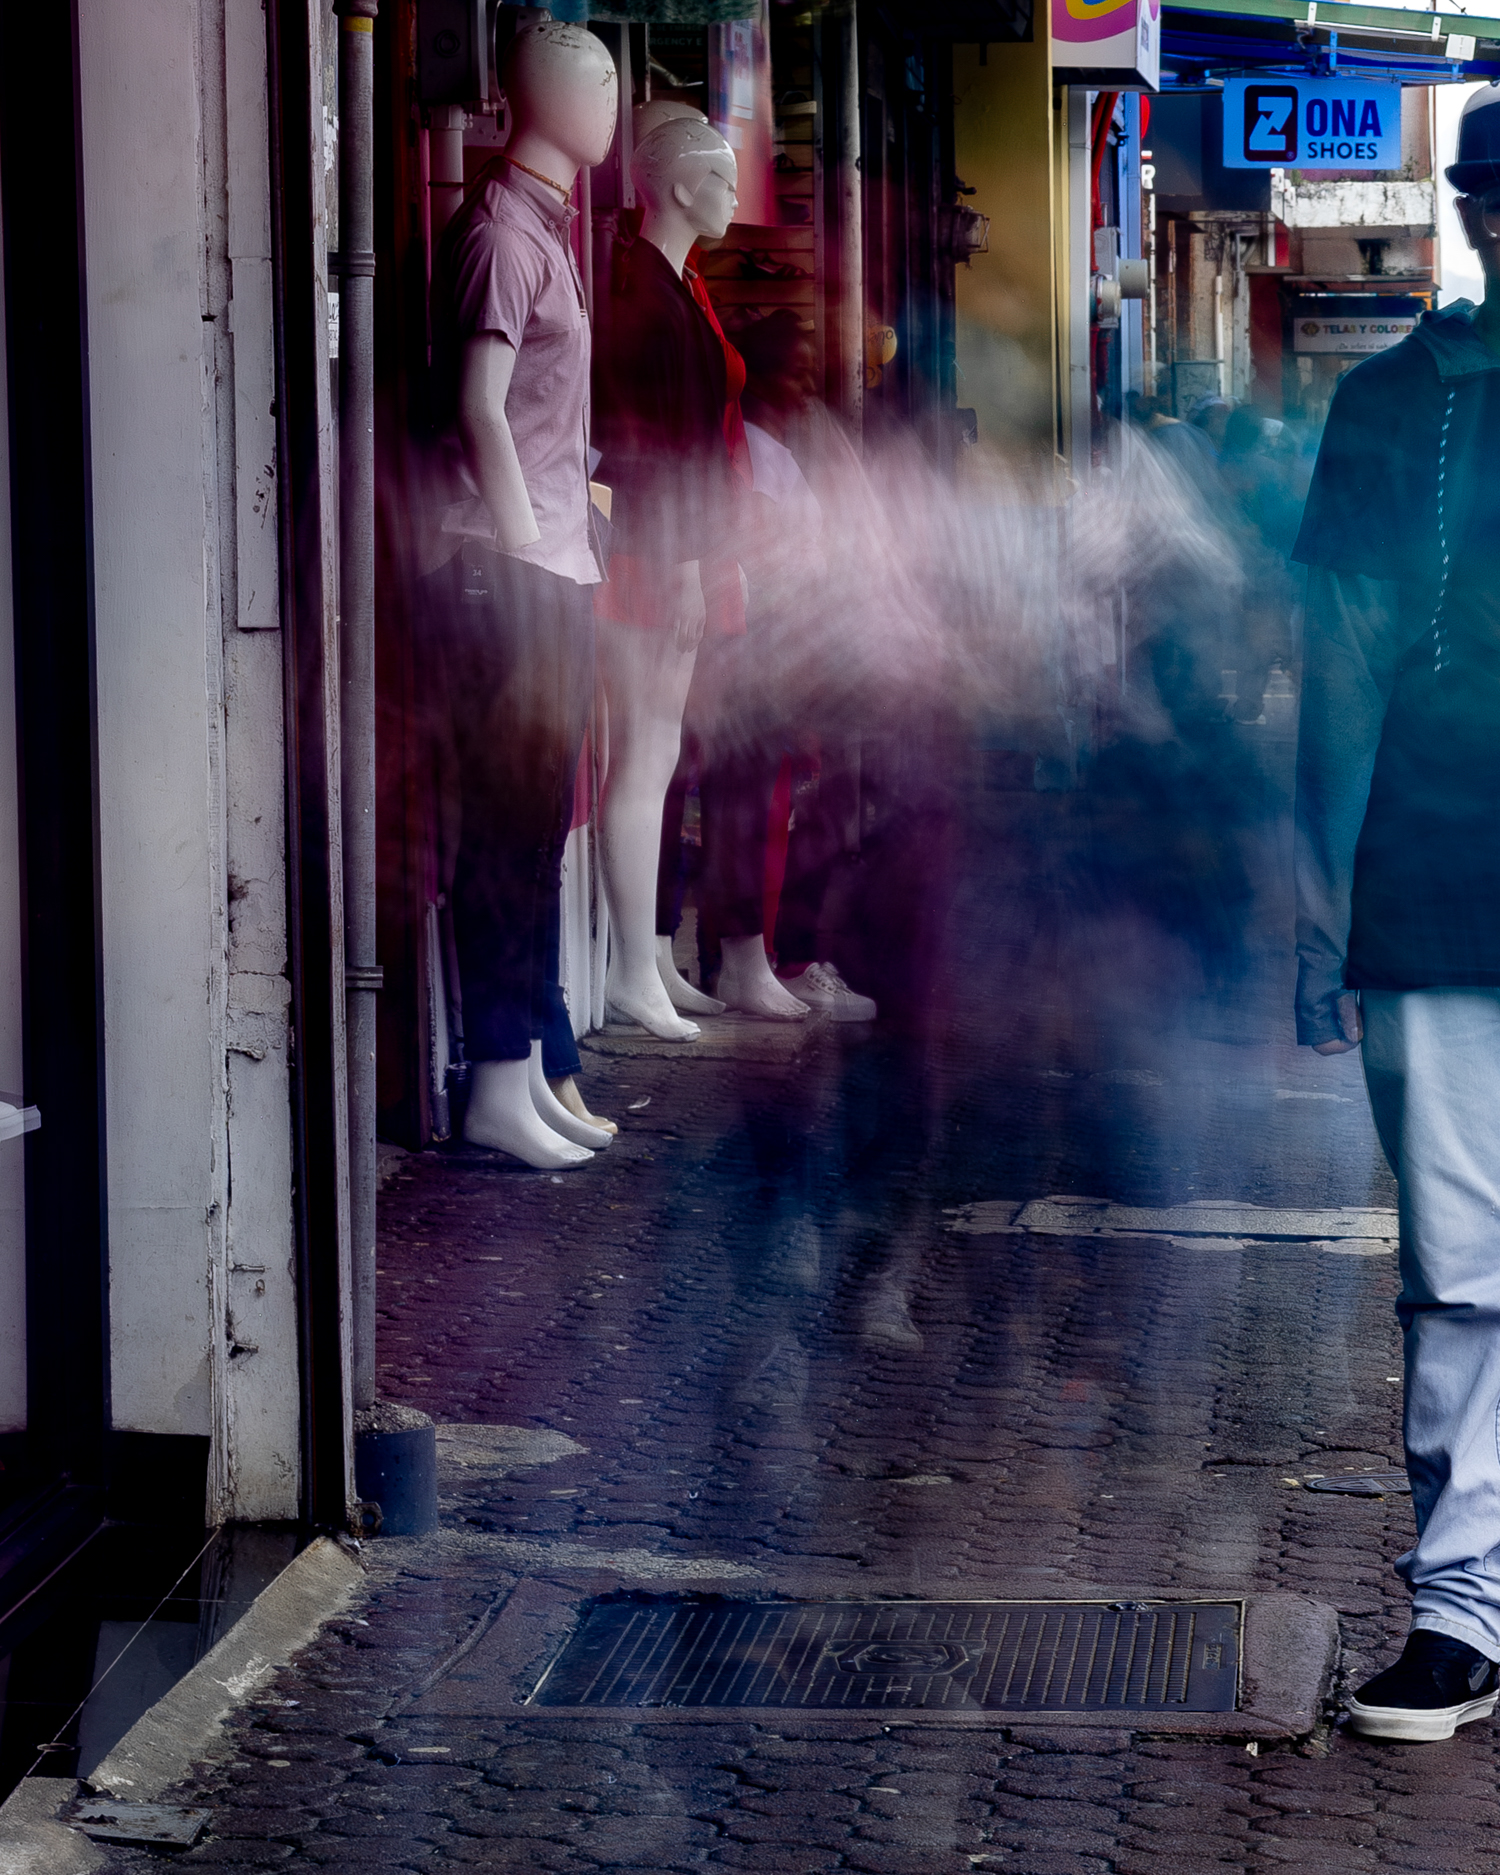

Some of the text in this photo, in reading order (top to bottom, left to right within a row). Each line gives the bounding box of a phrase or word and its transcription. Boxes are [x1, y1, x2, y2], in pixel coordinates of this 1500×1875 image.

[1308, 142, 1378, 159] SHOES
[1323, 324, 1412, 334] TELAS Y COLORE
